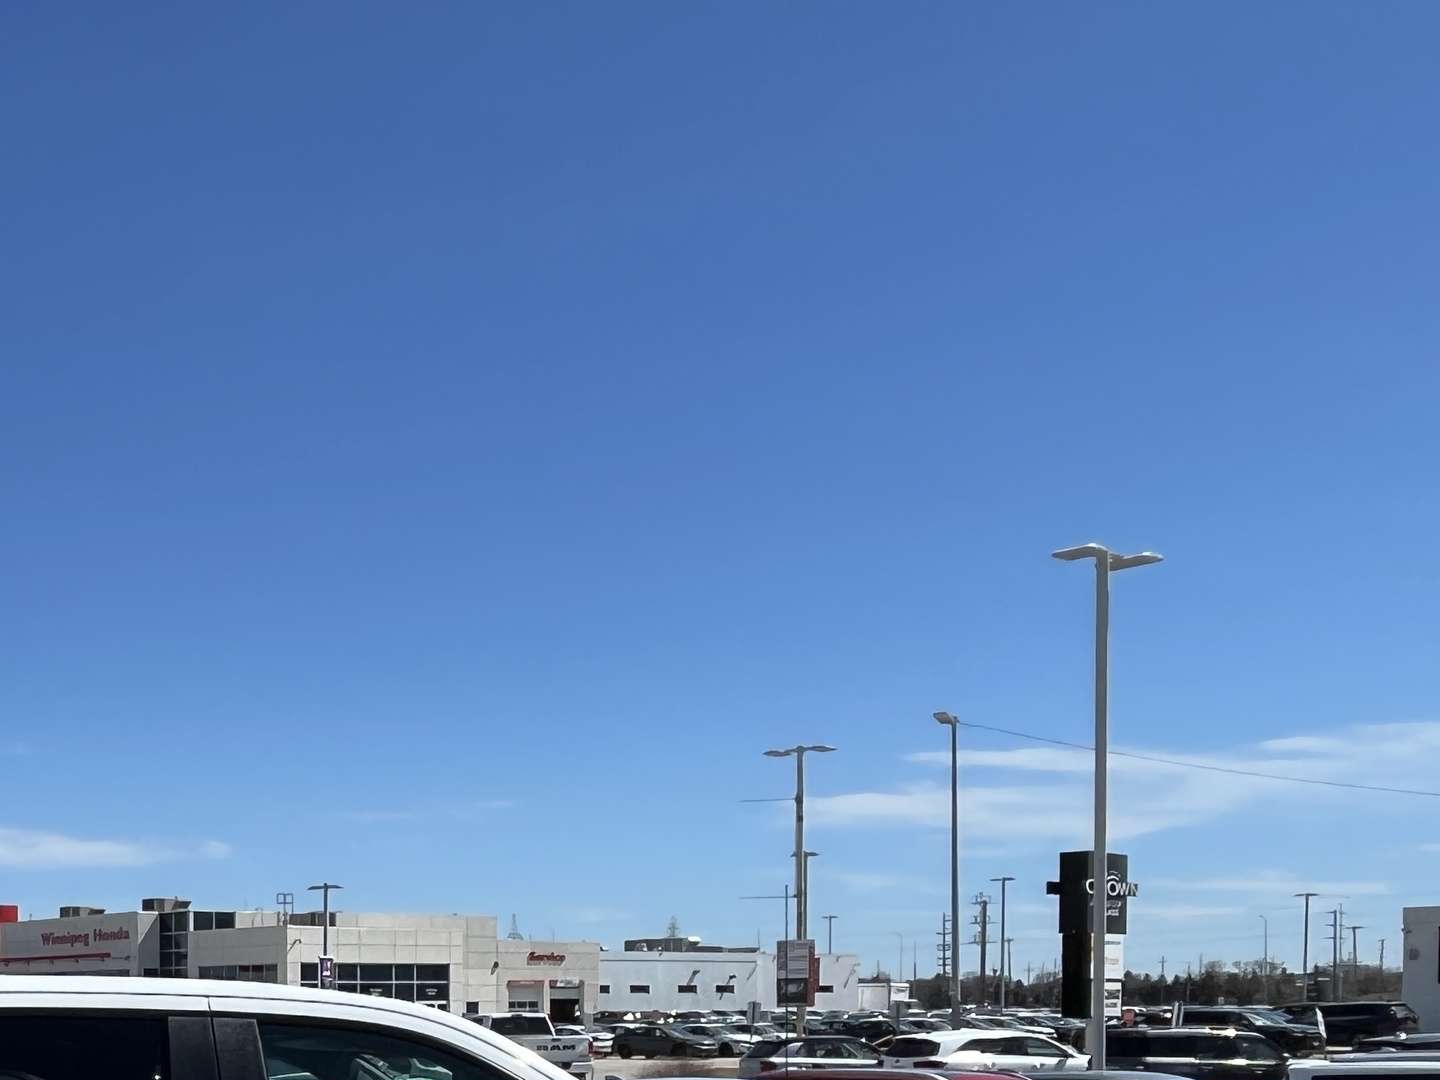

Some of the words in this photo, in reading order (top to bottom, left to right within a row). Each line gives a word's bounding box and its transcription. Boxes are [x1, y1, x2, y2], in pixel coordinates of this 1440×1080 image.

[1086, 878, 1138, 896] COWN
[41, 931, 90, 947] Winnipeg
[93, 926, 130, 942] Honda
